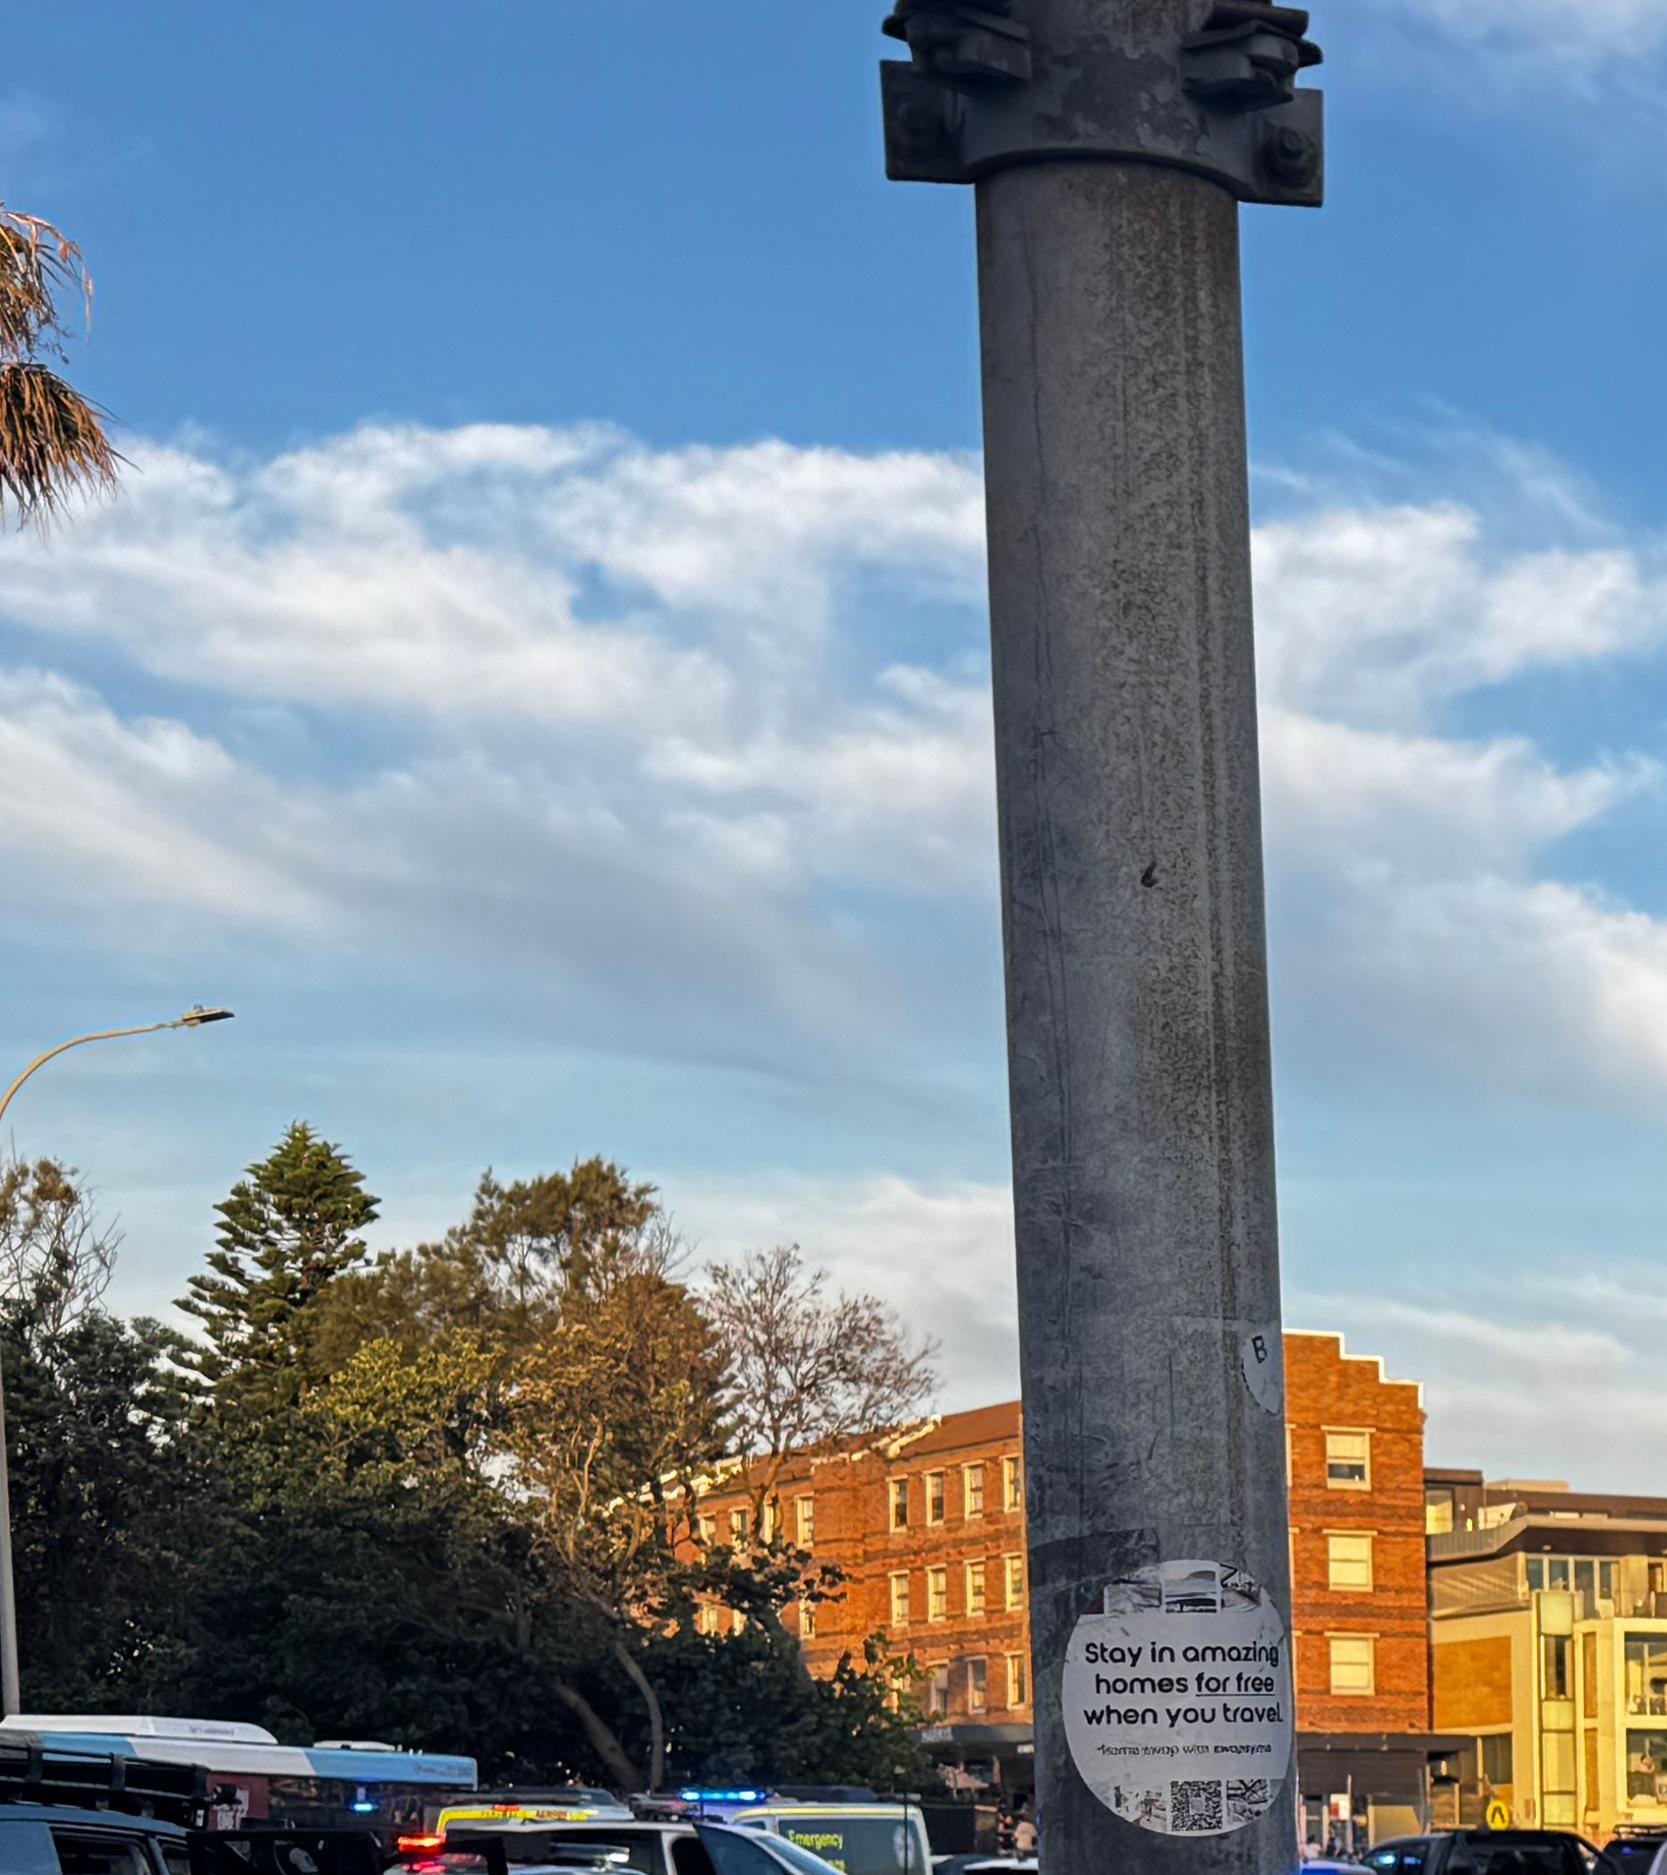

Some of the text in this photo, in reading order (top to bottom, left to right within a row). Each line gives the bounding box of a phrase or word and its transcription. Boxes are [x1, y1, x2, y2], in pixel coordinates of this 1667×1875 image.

[1085, 1641, 1279, 1668] Stay in amazing
[1095, 1671, 1275, 1694] homes for free
[1083, 1701, 1283, 1728] when you travel
